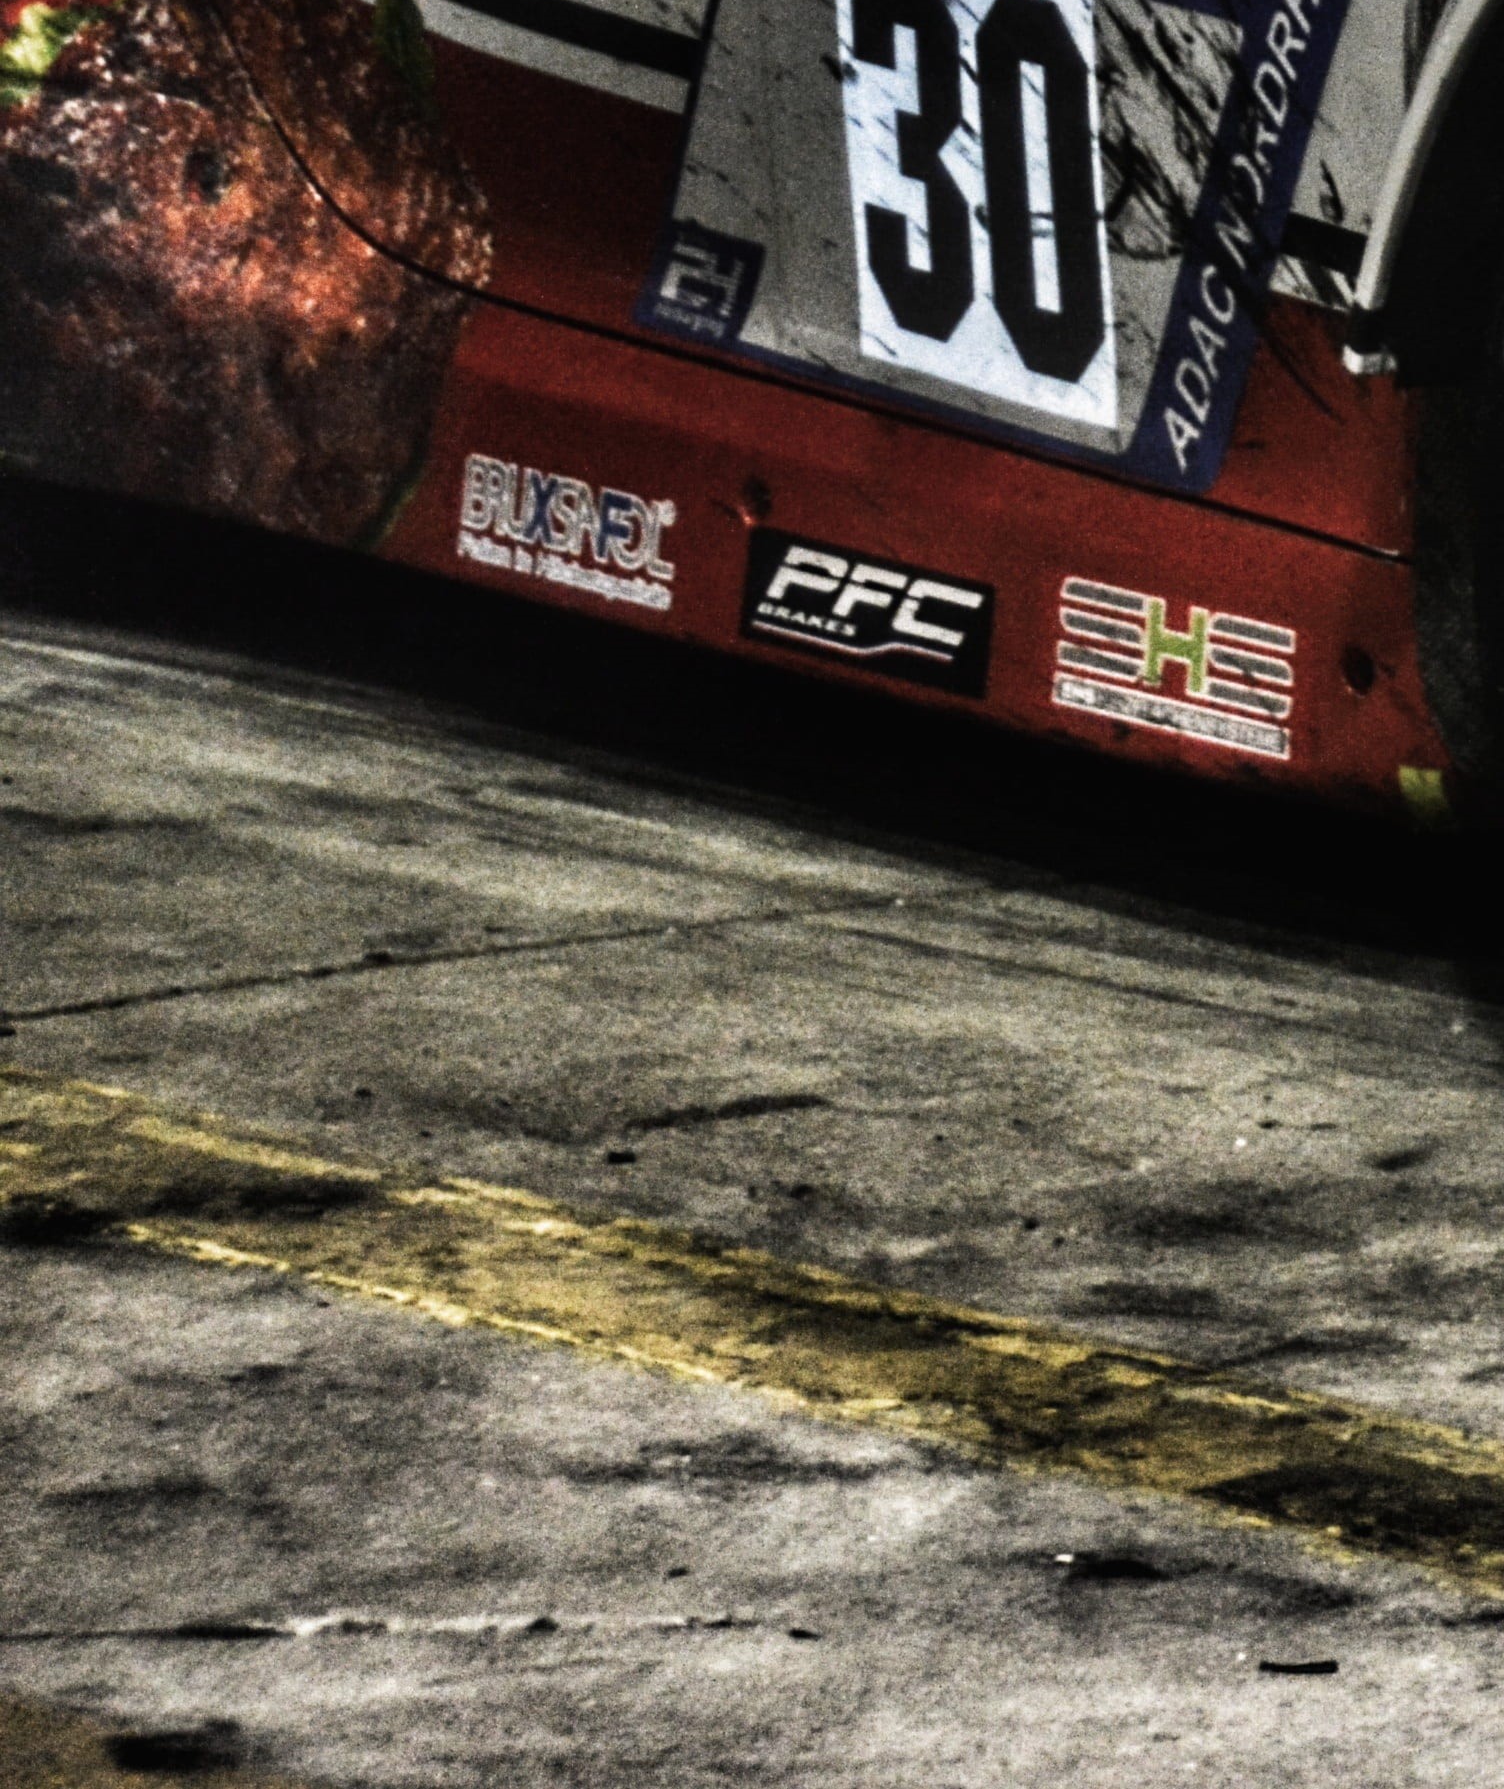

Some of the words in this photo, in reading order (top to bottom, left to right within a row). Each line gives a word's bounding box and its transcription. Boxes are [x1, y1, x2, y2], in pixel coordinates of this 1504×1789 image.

[1162, 264, 1237, 475] ADAC
[756, 601, 858, 638] BRAKES
[766, 544, 984, 648] PFC
